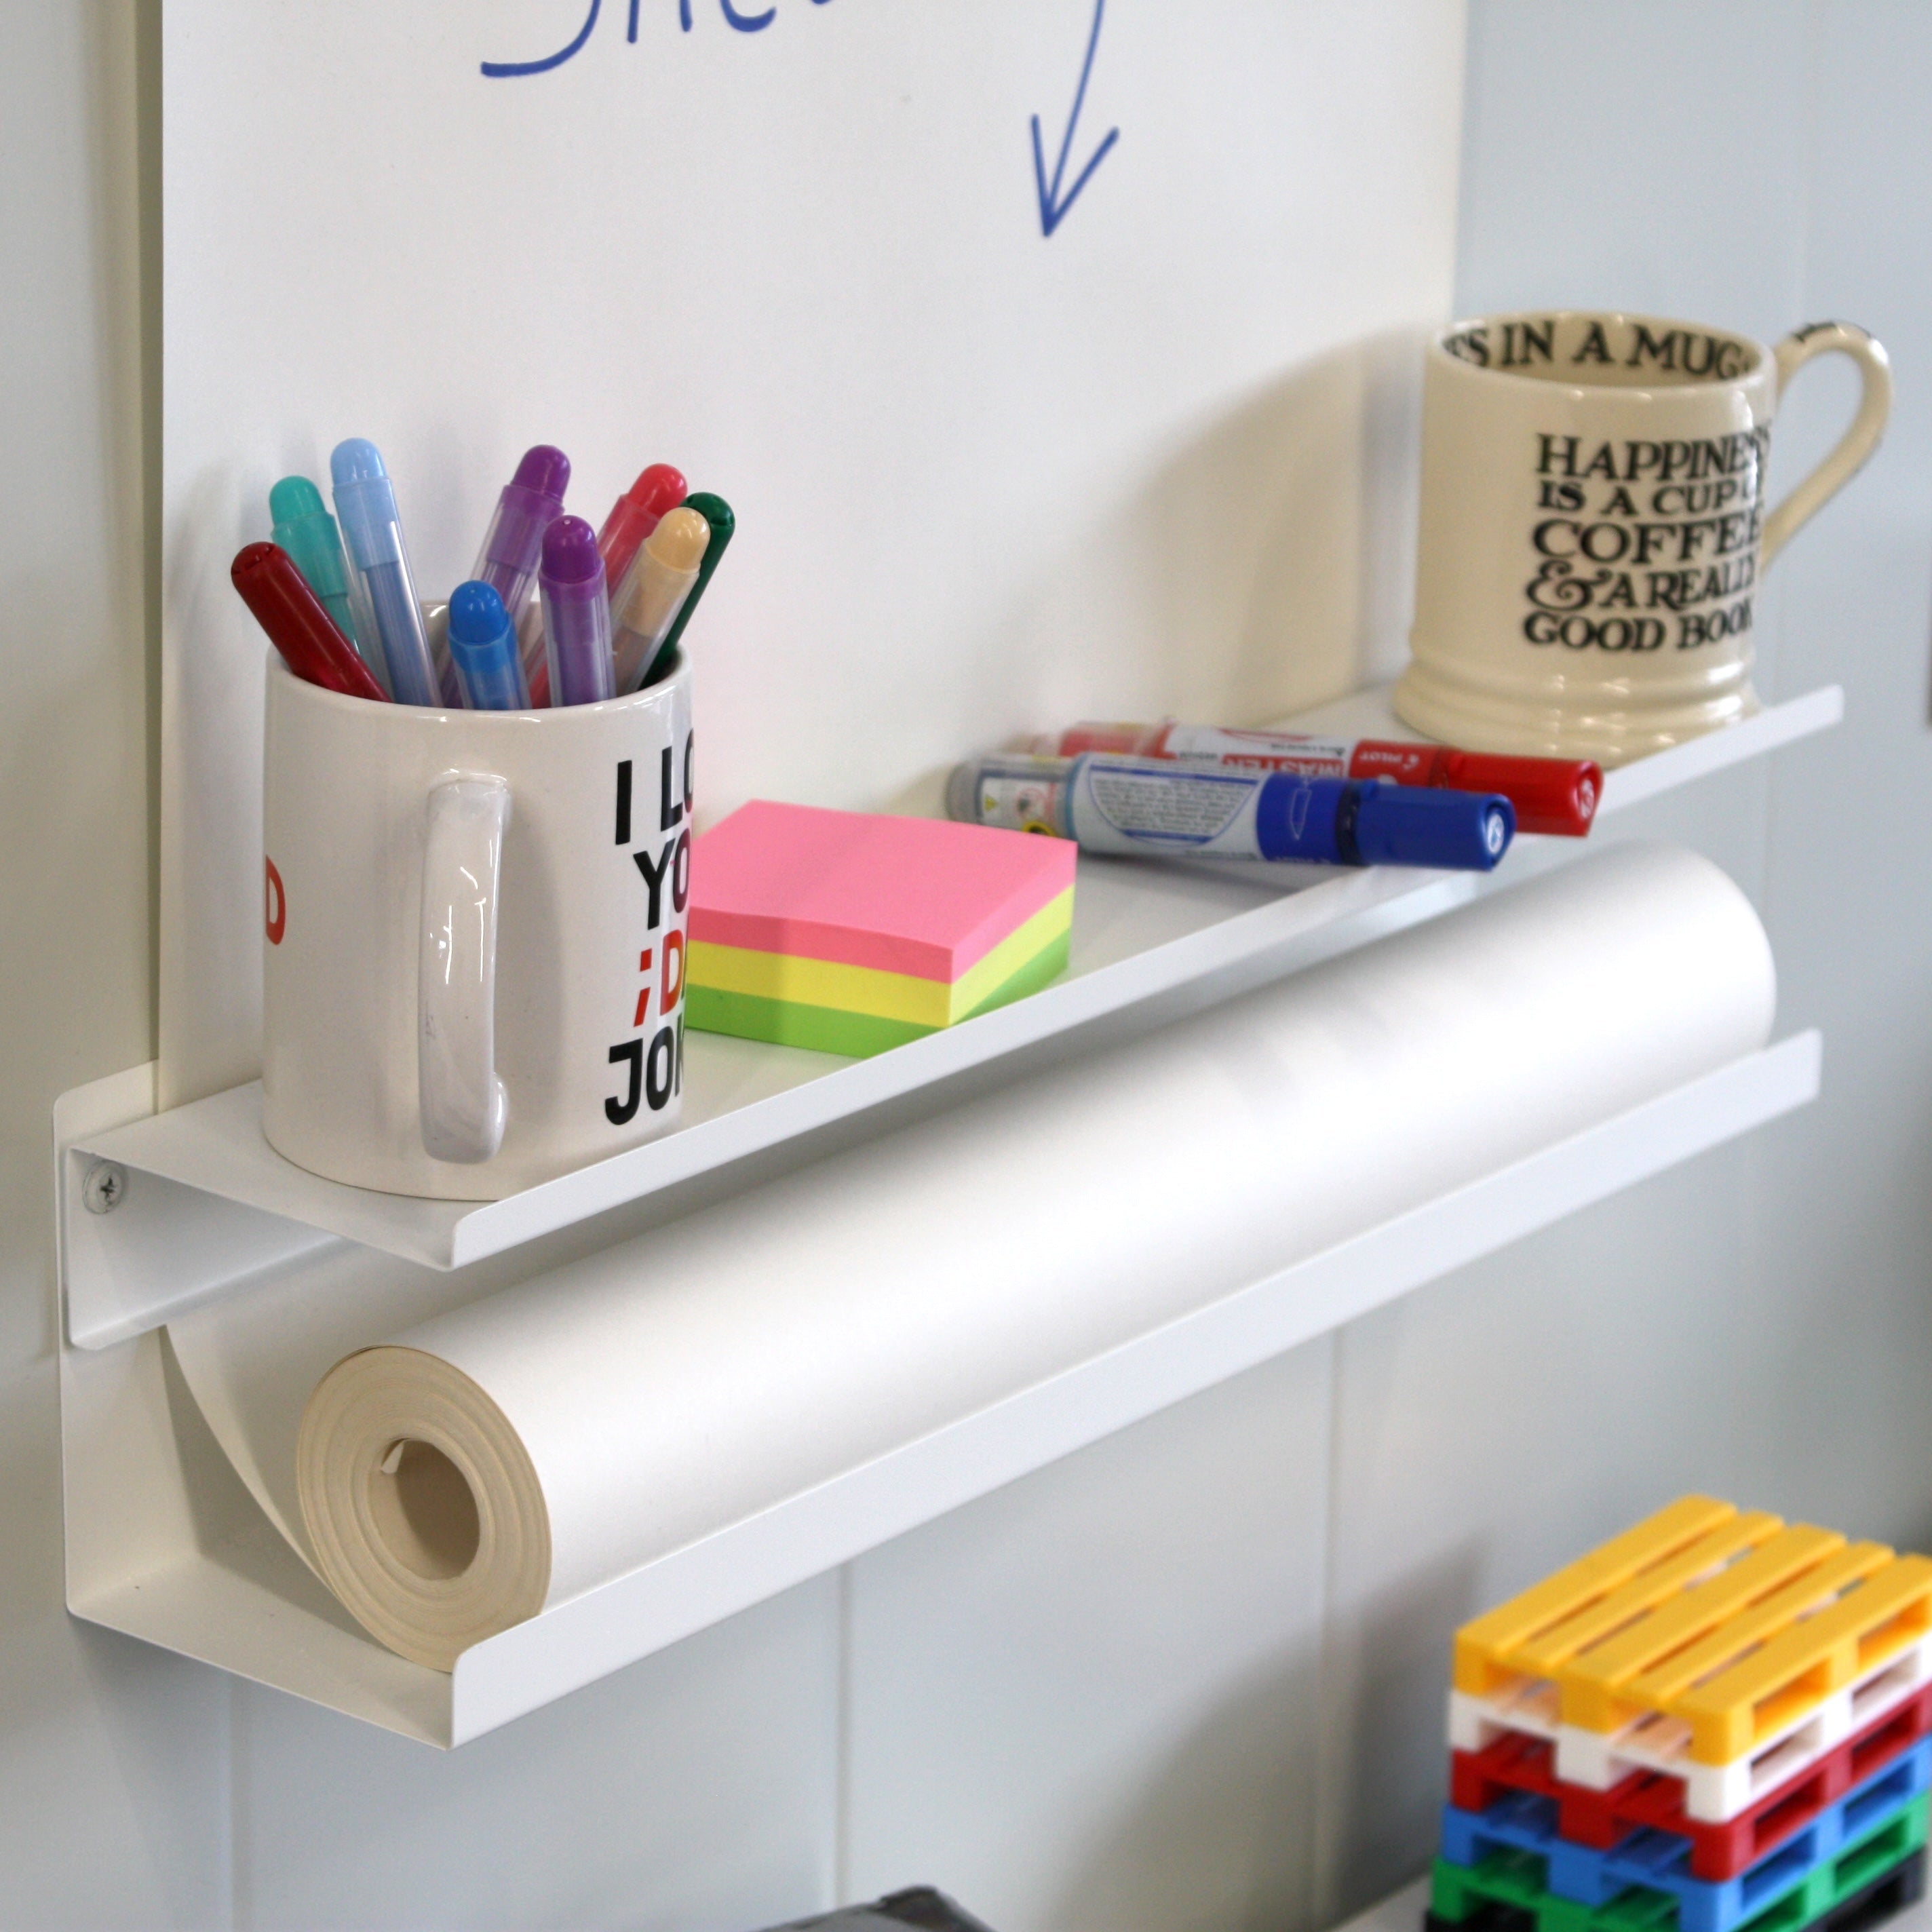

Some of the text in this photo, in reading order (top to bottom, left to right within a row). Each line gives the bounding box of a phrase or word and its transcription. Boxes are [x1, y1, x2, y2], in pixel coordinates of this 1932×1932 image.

[1501, 319, 1556, 366] IN
[1572, 322, 1615, 362] A
[1536, 422, 1771, 481] HAPPINES
[1538, 480, 1587, 511] IS
[1601, 486, 1639, 517] A
[1650, 478, 1738, 516] CUP
[1524, 559, 1613, 611] &
[1598, 573, 1640, 608] A
[1522, 611, 1667, 652] GOOD
[615, 760, 632, 845] I
[633, 828, 691, 930] YO
